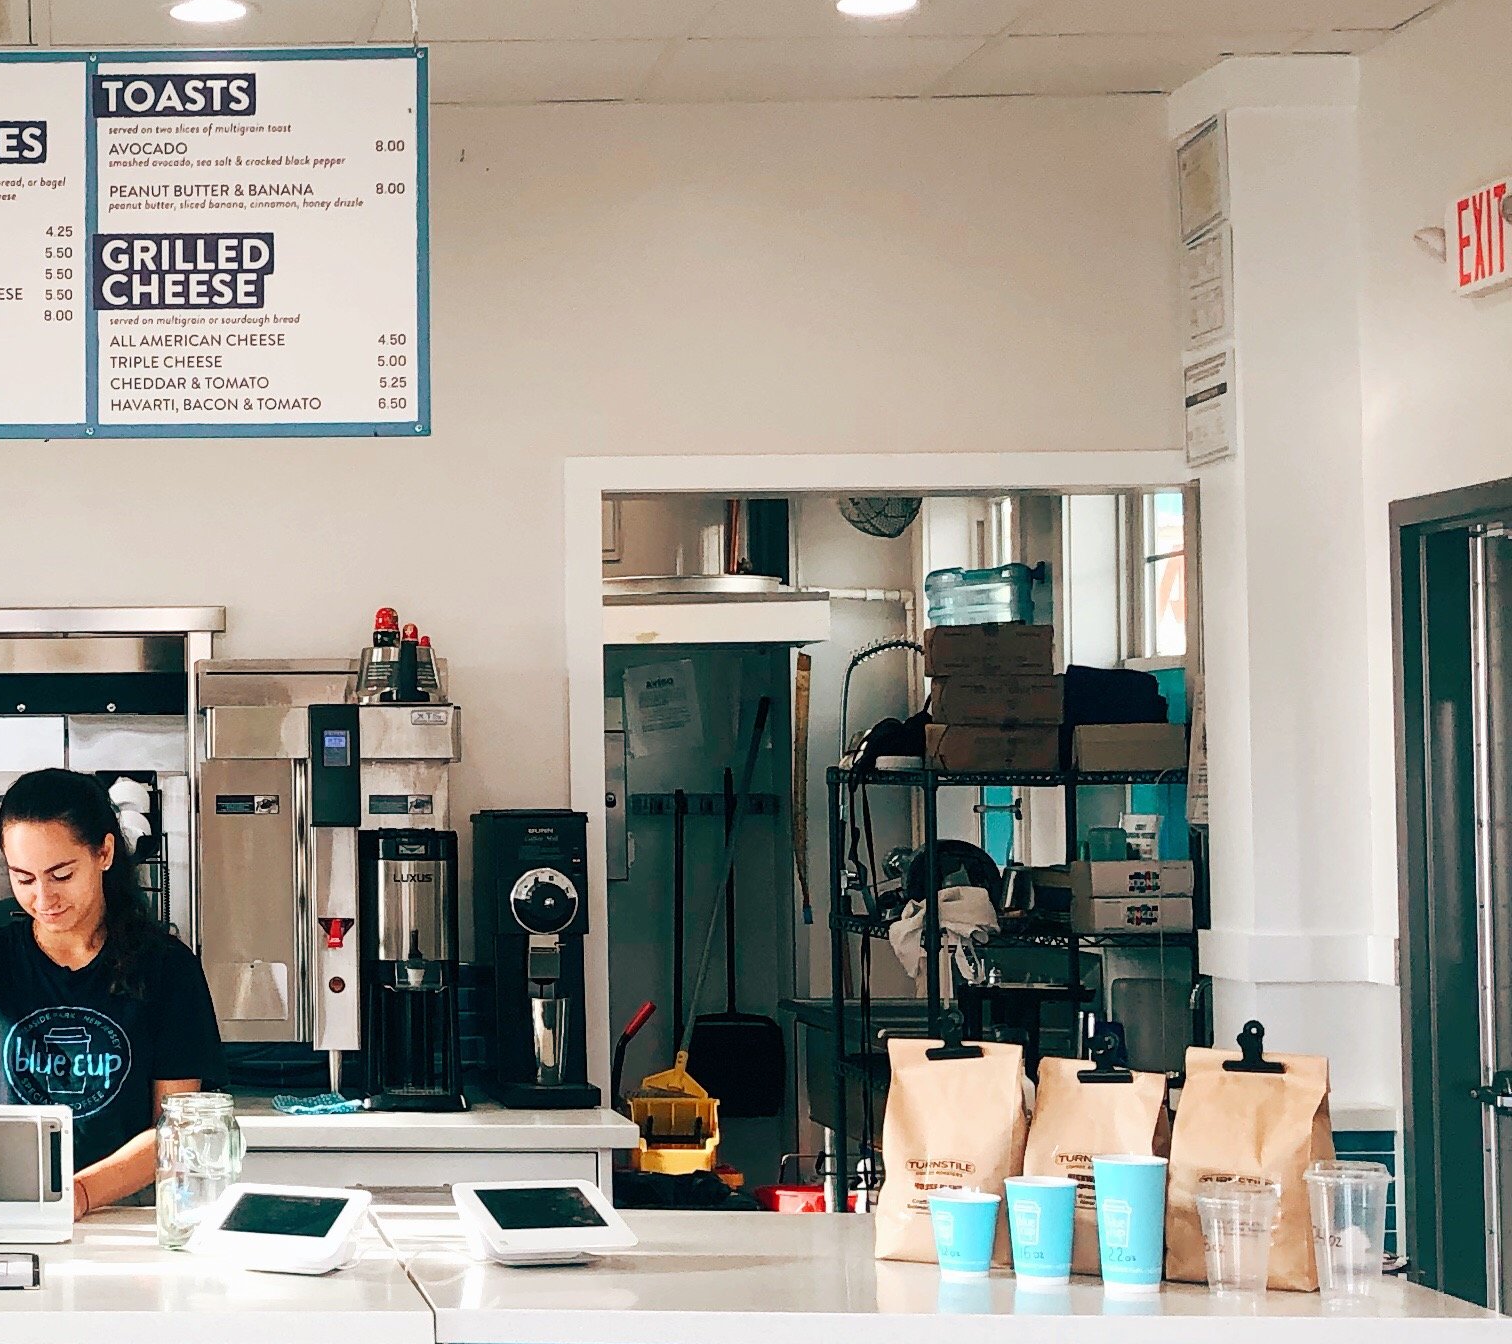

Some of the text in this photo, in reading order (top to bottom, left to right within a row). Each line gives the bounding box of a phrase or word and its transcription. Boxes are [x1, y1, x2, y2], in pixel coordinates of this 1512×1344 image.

[101, 79, 250, 113] TOASTS
[108, 141, 188, 156] AVOCADO
[109, 183, 314, 198] PEANUT BUTTER & BANANA
[1457, 182, 1507, 288] EXIT
[101, 238, 270, 271] GRILLED
[101, 273, 258, 306] CHEESE
[109, 333, 286, 348] ALL AMERICAN CHEESE
[109, 355, 223, 369] TRIPLE CHEESE
[110, 376, 270, 390] CHEDDAR & TOMATO
[111, 397, 322, 414] HAVARTI, BACON & TOMATO
[393, 873, 434, 884] LUXUS
[15, 1036, 122, 1090] blue cup
